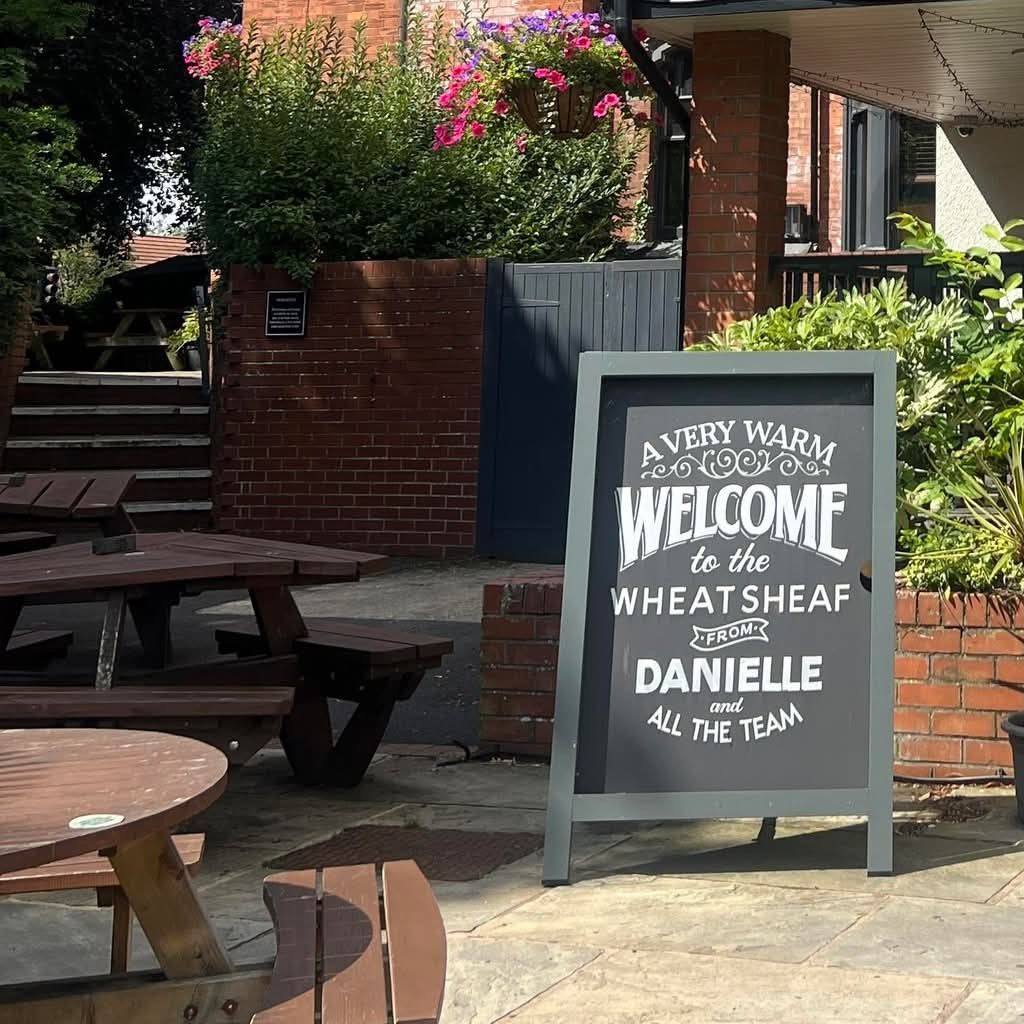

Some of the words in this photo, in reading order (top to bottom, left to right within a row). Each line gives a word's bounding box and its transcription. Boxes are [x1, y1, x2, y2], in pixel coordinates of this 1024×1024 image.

[641, 441, 664, 467] A
[661, 420, 736, 454] VERY
[743, 420, 838, 467] WARM
[615, 483, 849, 572] WELCOME
[690, 546, 720, 574] to
[728, 543, 770, 574] the
[611, 583, 851, 616] WHEATSHEAF
[635, 655, 823, 694] DANIELLE
[647, 705, 682, 737] ALL
[692, 718, 732, 744] THE
[739, 702, 804, 742] TEAM
[709, 697, 744, 713] and
